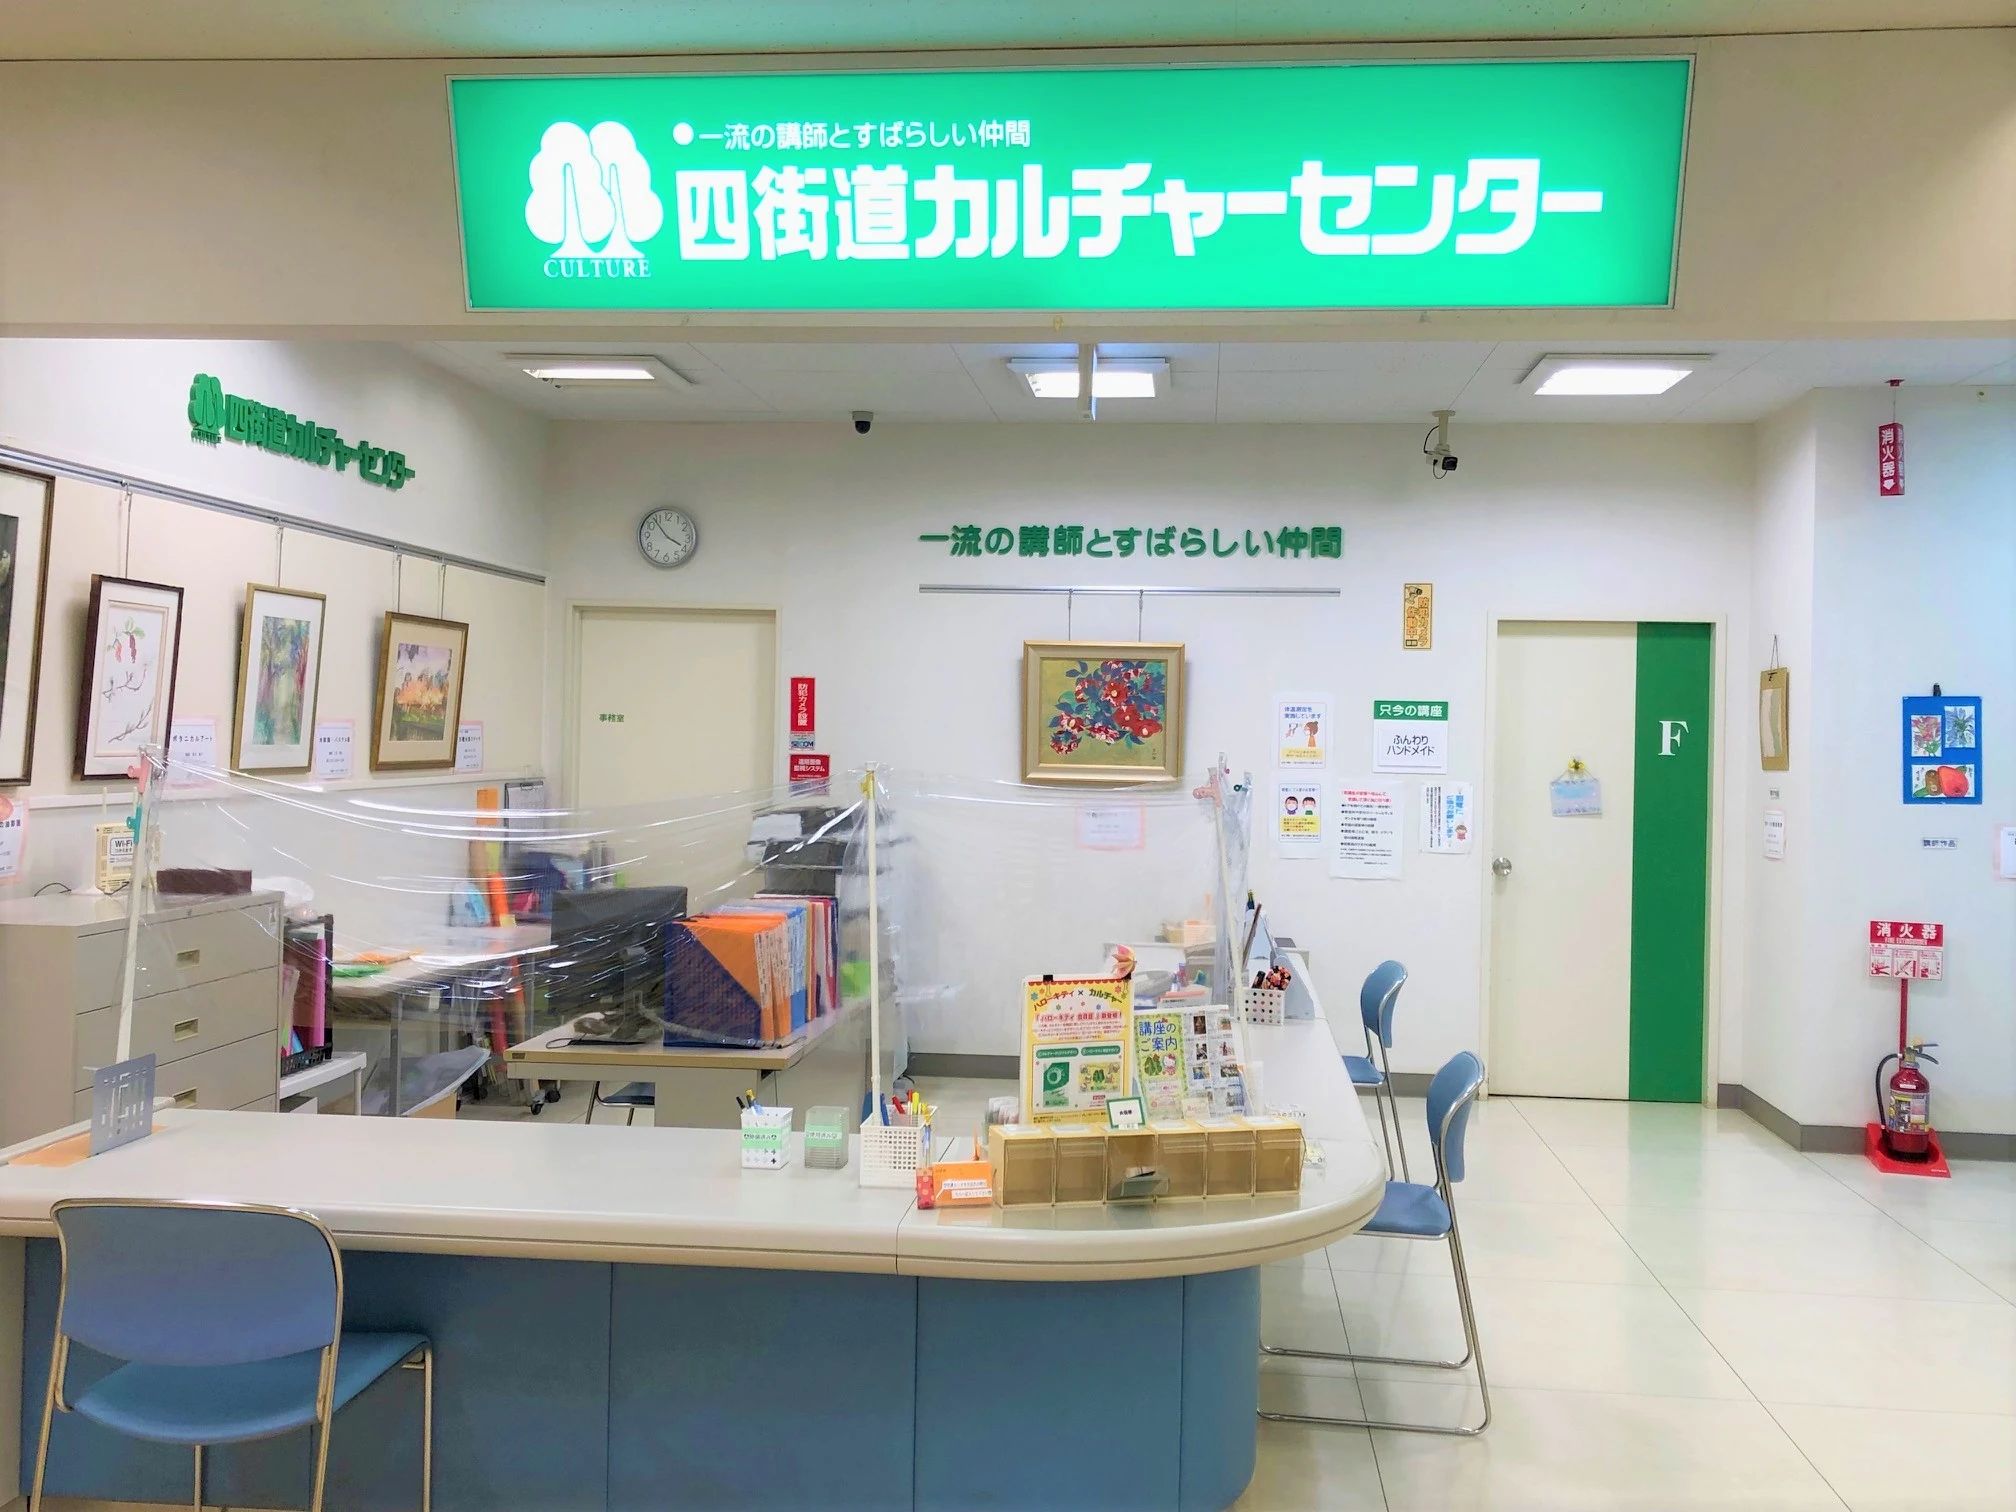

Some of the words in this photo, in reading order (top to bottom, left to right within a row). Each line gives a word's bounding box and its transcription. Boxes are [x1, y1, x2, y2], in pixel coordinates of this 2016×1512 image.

[699, 119, 1031, 150] 一流の講師とすばらしい仲間
[675, 158, 1604, 262] 四街道カルチャーセンター
[543, 258, 652, 278] CULTURE
[225, 393, 416, 490] 四街道カルチャーセンター
[1881, 427, 1896, 478] 消火器
[918, 524, 1344, 559] 一流の講師とすばらしい仲間
[1379, 704, 1443, 717] 只今の講座
[1393, 734, 1429, 745] ふんわり
[1658, 720, 1689, 756] F
[1387, 746, 1436, 756] ハンドメイド
[1877, 922, 1937, 939] 消火器
[1138, 1020, 1177, 1036] 講座の
[1140, 1035, 1178, 1052] ご案内
